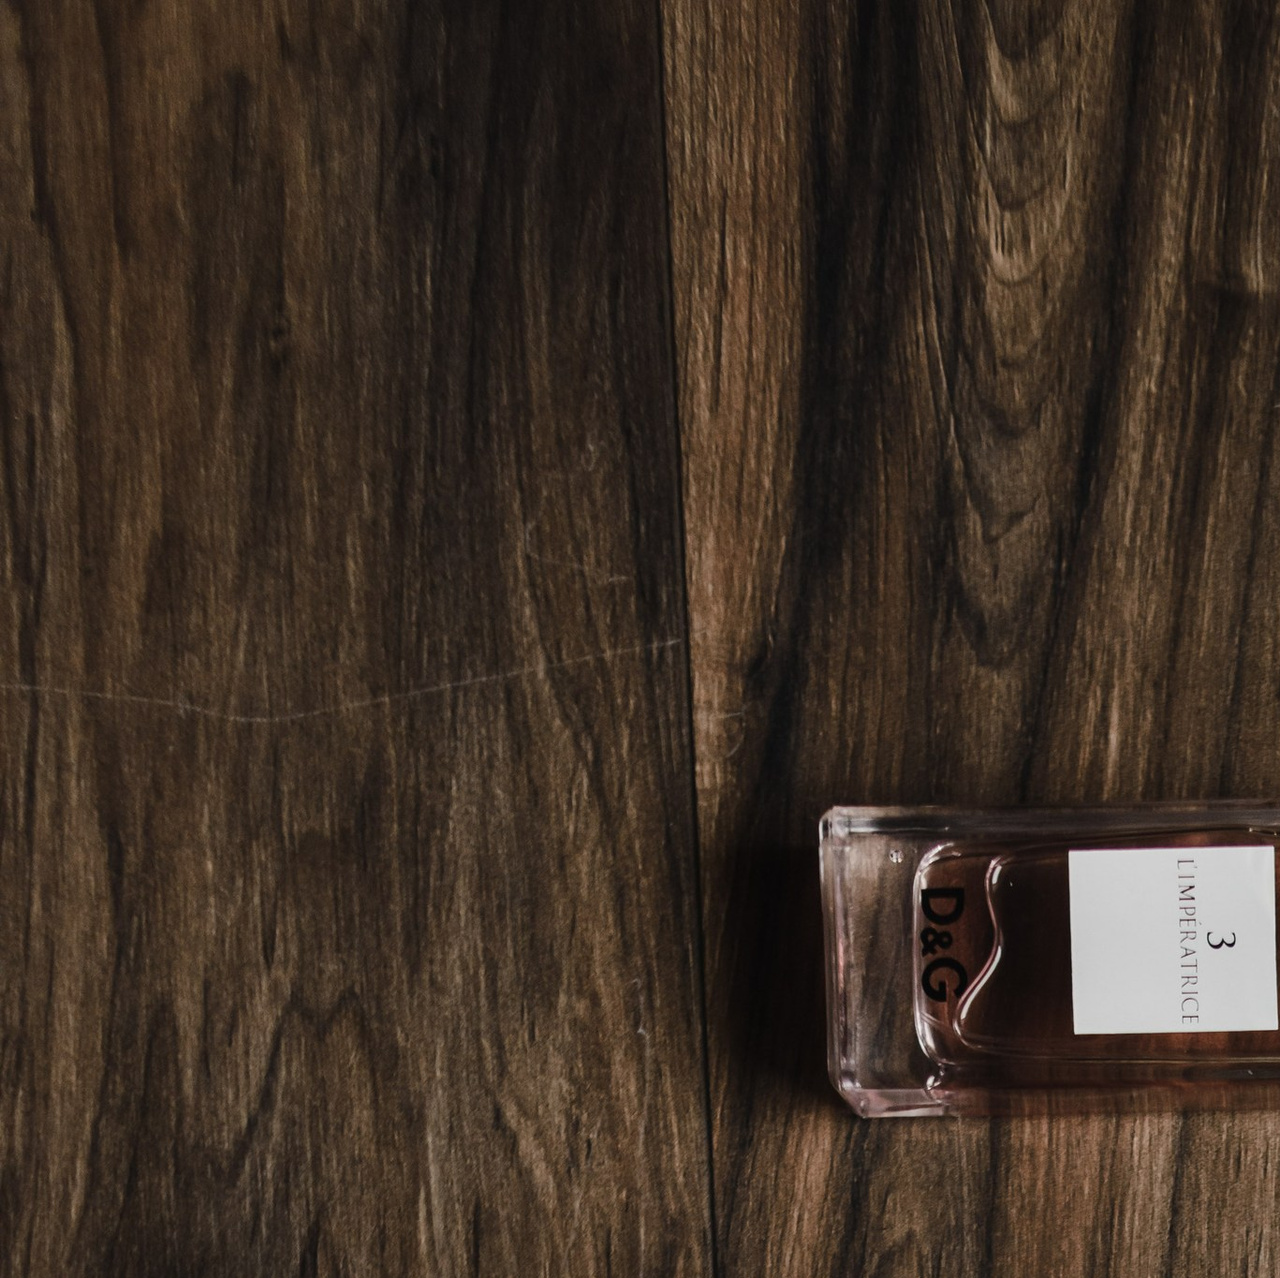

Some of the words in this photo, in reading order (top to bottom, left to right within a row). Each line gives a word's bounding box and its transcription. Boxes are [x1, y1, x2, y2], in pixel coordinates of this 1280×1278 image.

[921, 888, 968, 1002] D&G
[1177, 859, 1202, 1024] L'IMPÉRATRICE
[1206, 932, 1236, 950] 3
